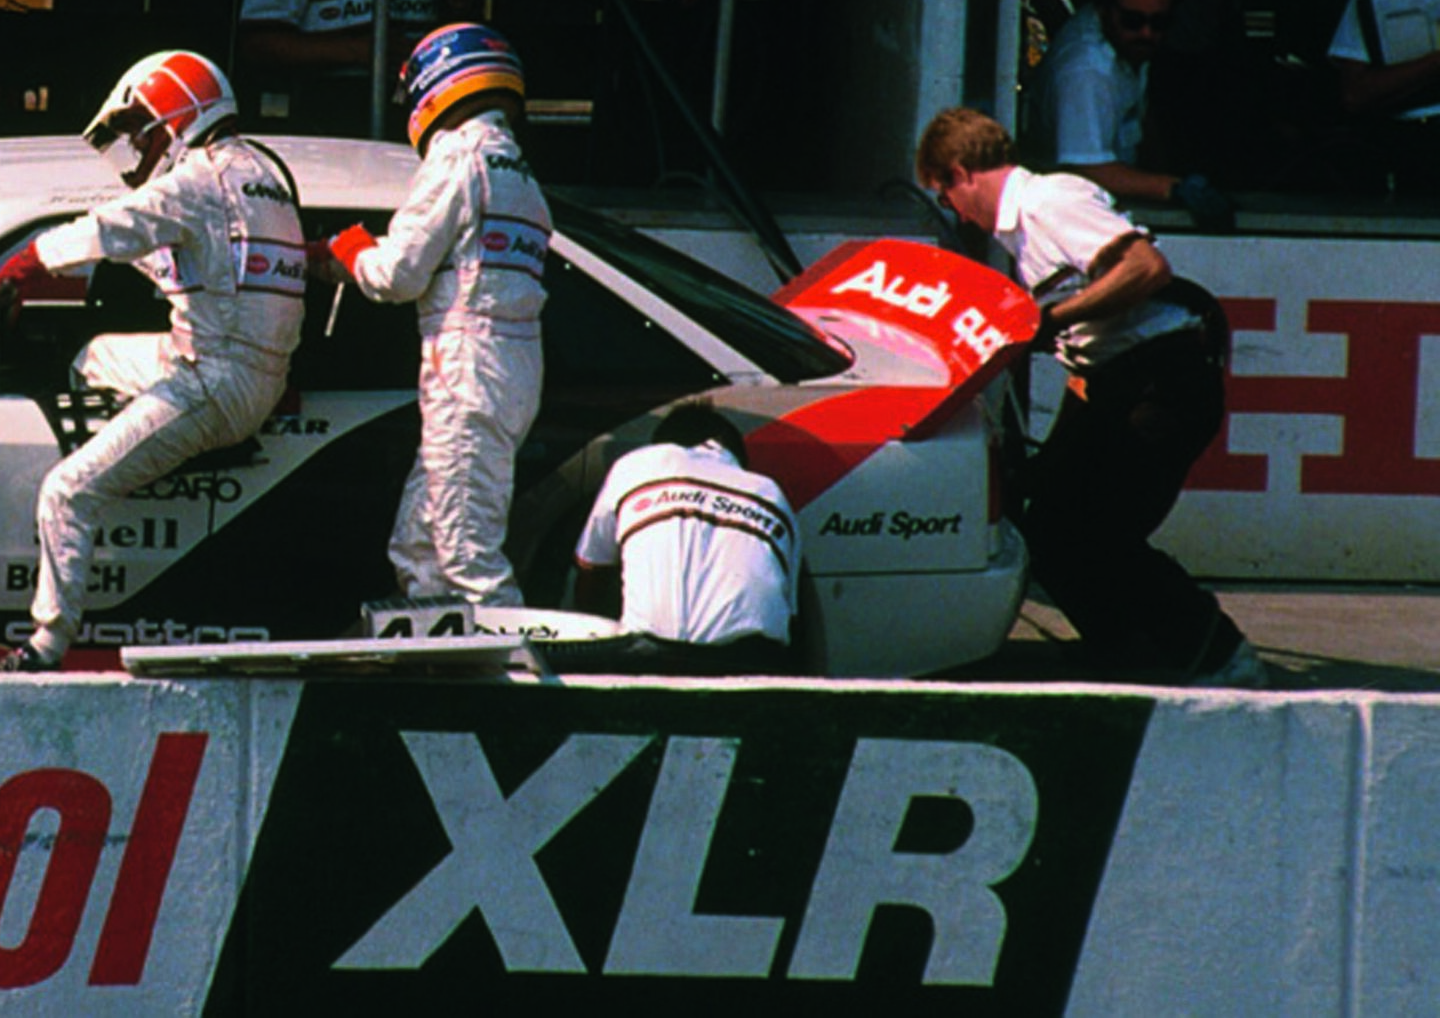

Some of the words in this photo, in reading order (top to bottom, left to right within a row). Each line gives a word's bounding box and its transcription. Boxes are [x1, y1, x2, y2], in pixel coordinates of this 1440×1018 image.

[829, 261, 953, 319] Audi
[657, 490, 707, 505] Audi
[712, 495, 774, 530] Sport
[819, 511, 886, 537] Audi
[888, 510, 963, 541] Sport
[330, 728, 1040, 989] XLR
